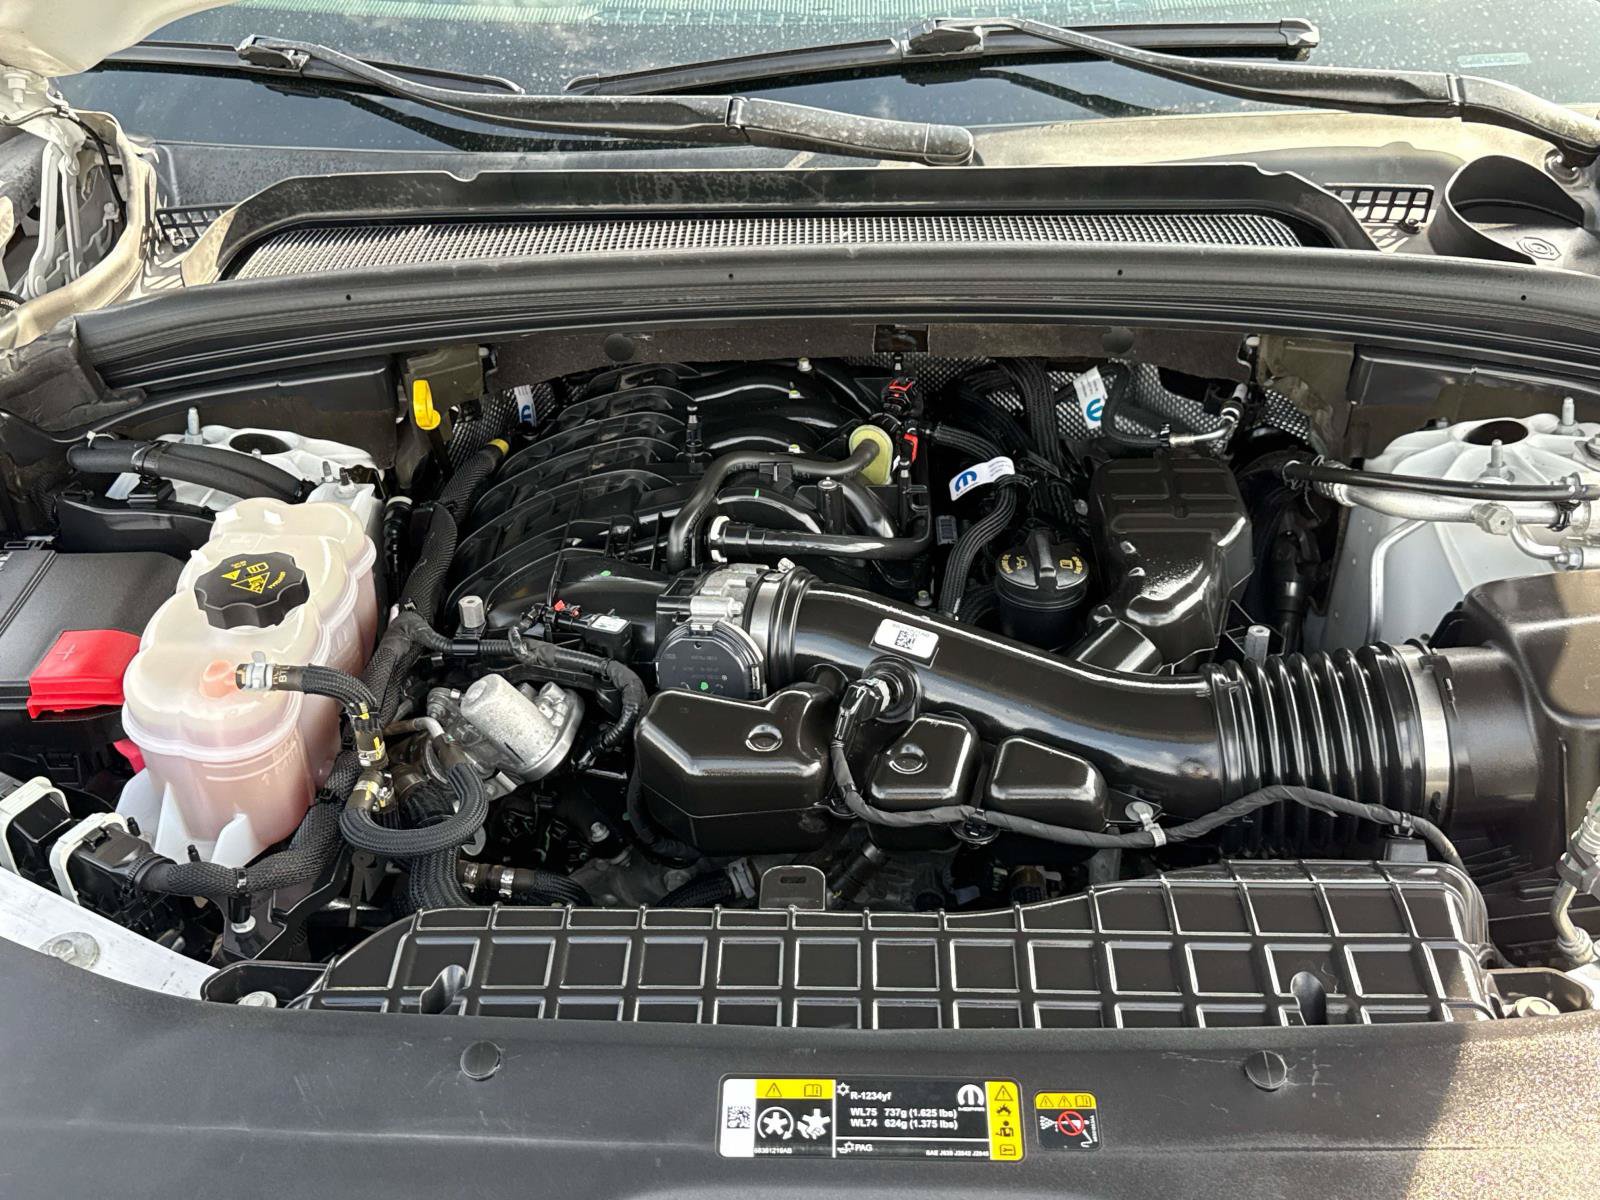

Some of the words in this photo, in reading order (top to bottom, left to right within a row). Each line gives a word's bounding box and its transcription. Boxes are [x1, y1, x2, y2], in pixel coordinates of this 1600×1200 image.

[850, 1091, 892, 1102] R-1234yf
[850, 1107, 878, 1117] WL75
[884, 1107, 907, 1119] 737g
[909, 1108, 938, 1119] (1.625
[939, 1108, 958, 1120] lbs)
[850, 1118, 878, 1128] WL74
[884, 1118, 908, 1130] 624g
[909, 1119, 938, 1130] (1.375
[939, 1119, 959, 1131] lbs)
[855, 1144, 873, 1152] PAG
